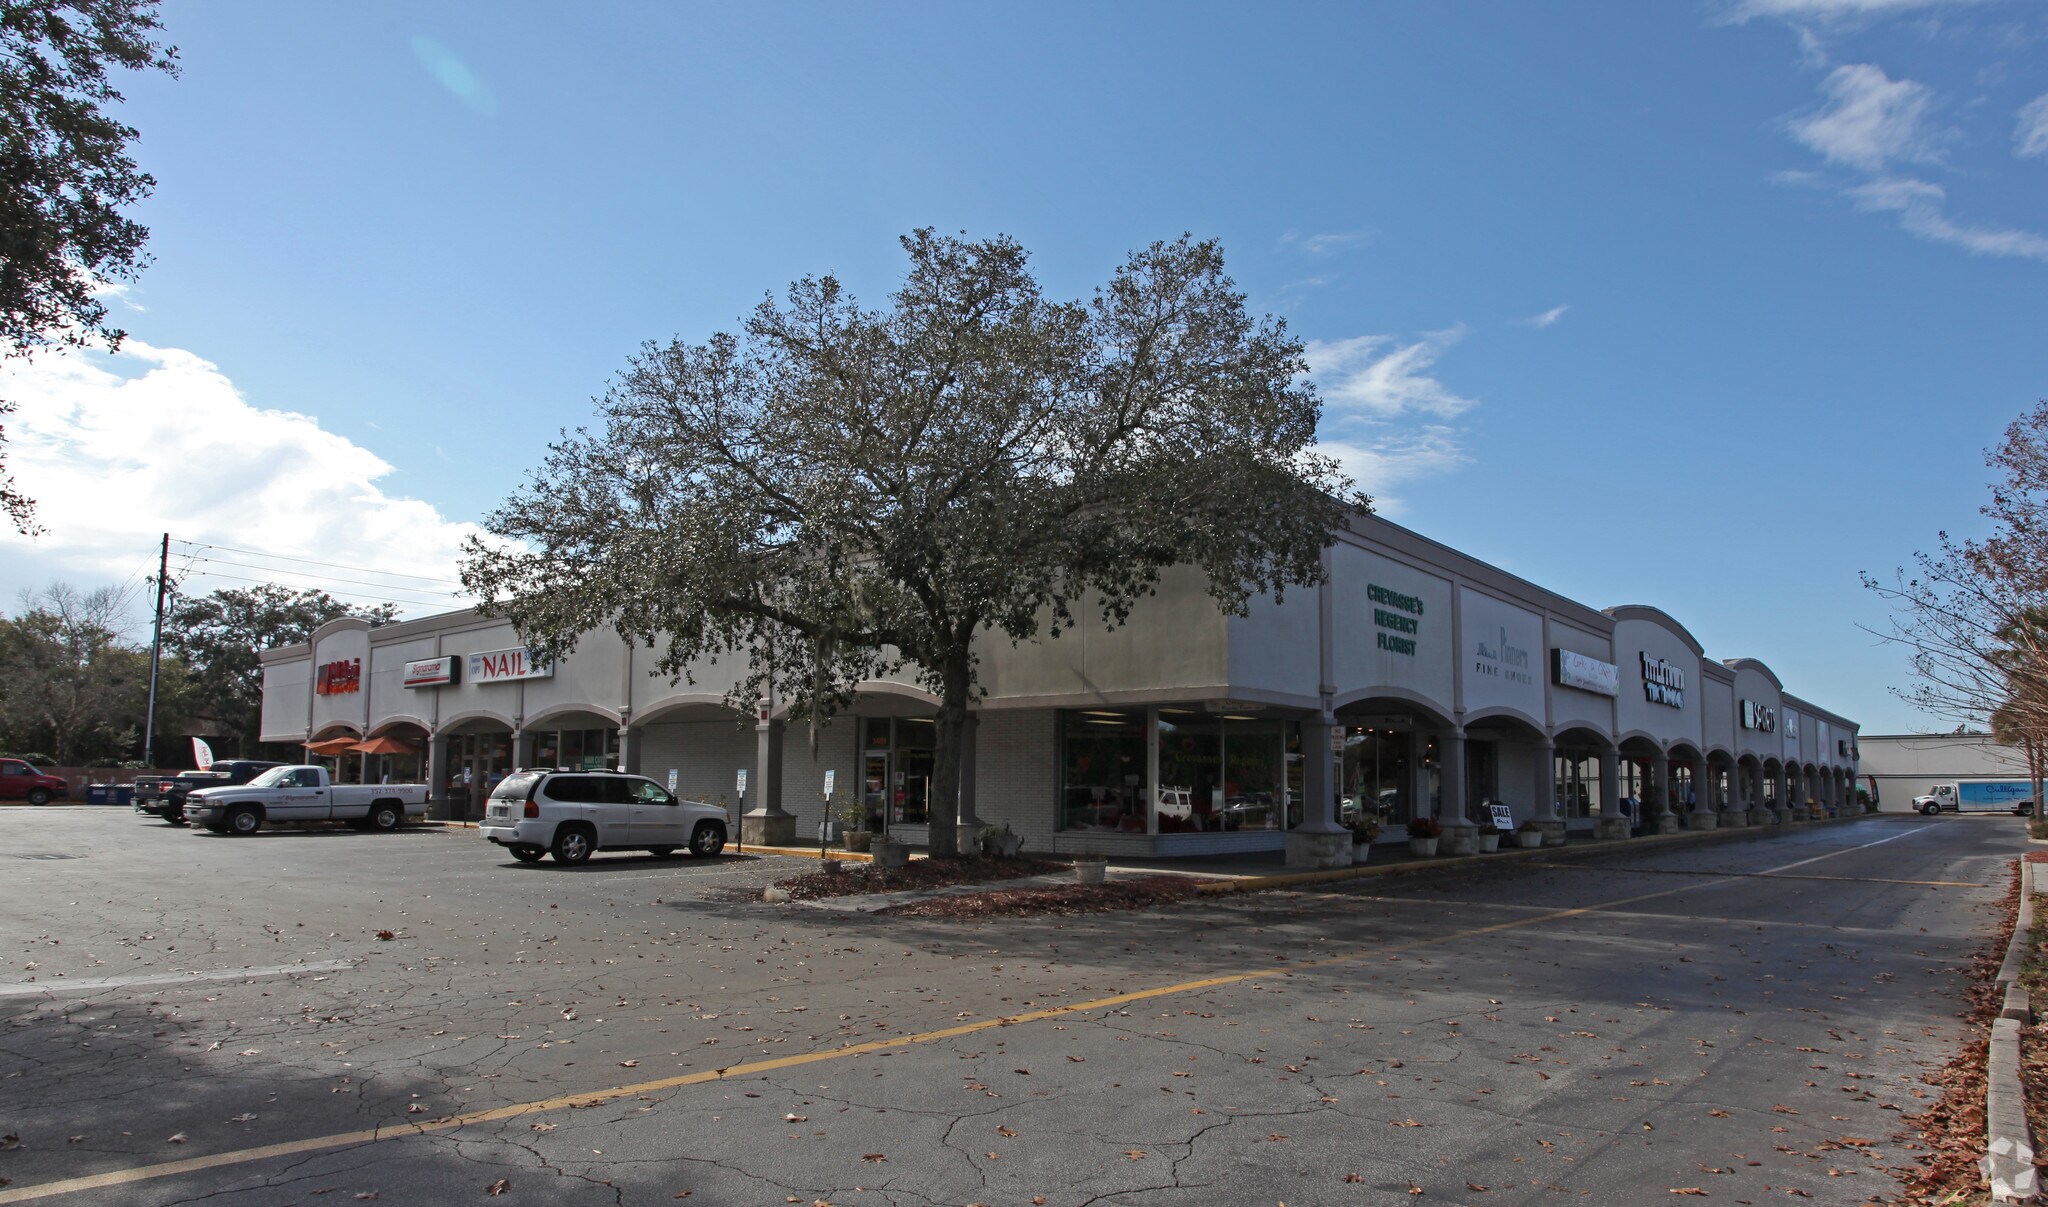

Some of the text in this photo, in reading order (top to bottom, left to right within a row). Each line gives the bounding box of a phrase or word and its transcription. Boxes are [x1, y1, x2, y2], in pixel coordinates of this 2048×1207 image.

[1374, 608, 1418, 635] REGENCY
[1378, 632, 1417, 656] FLORIST
[482, 651, 527, 678] NAIL
[1476, 662, 1532, 685] FINE SHOES
[1985, 785, 2028, 796] Culligan
[1492, 807, 1510, 817] SALE
